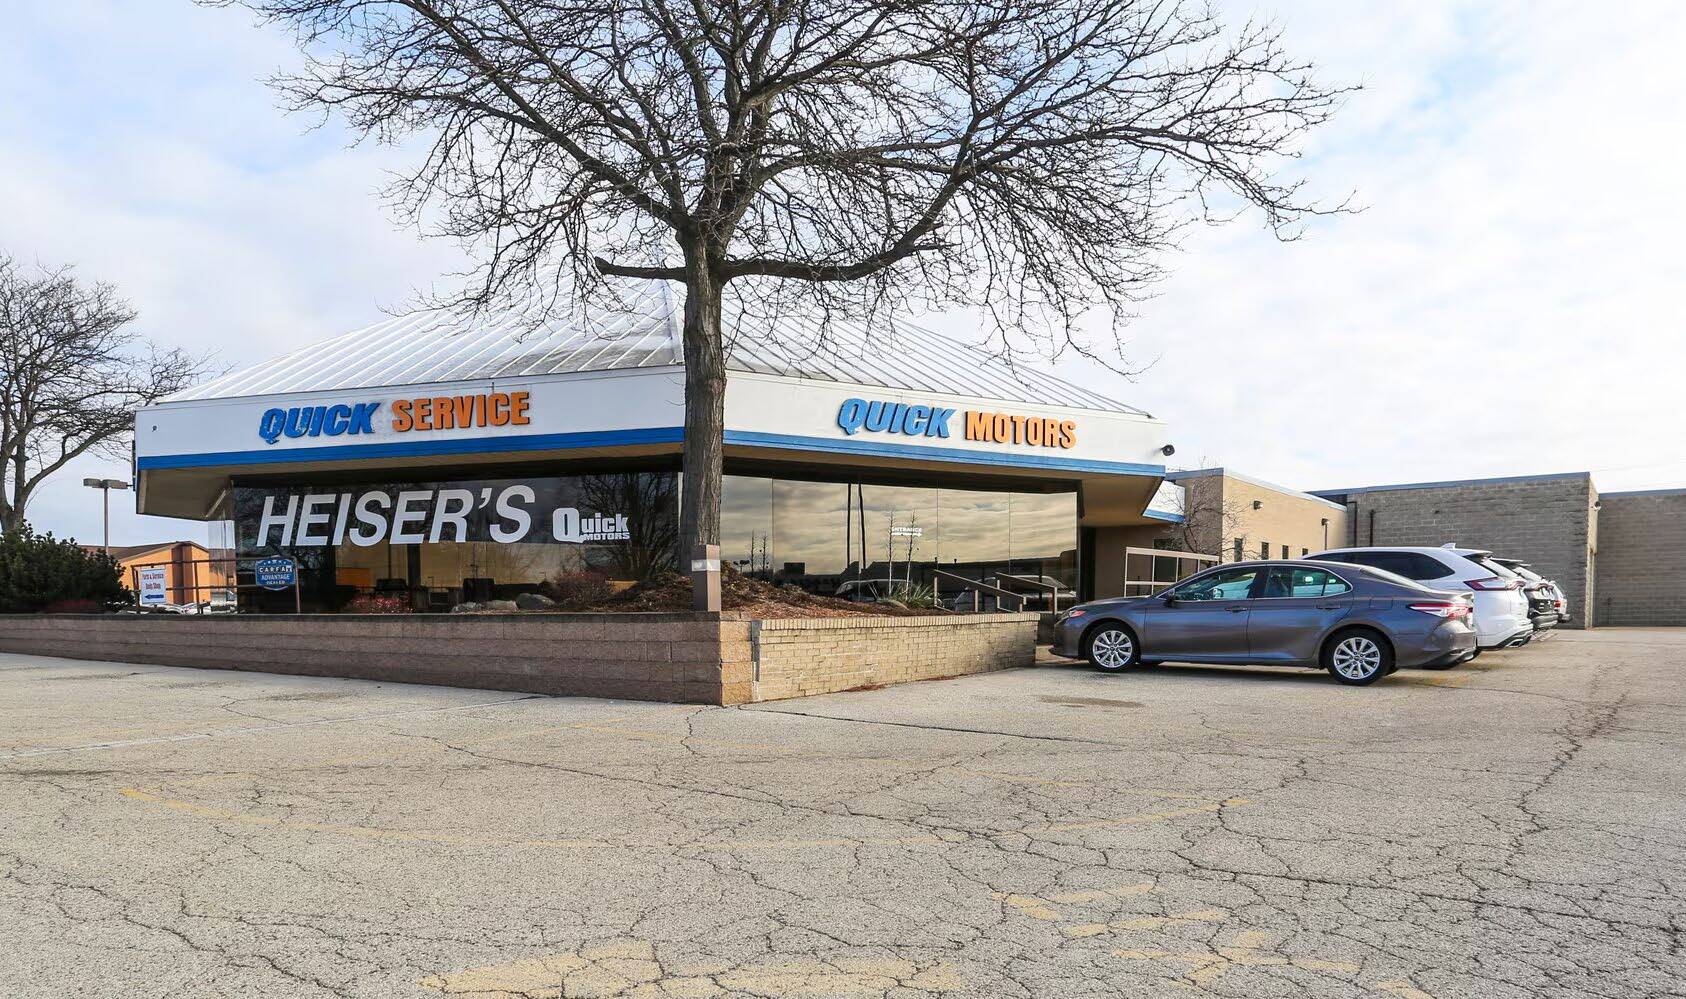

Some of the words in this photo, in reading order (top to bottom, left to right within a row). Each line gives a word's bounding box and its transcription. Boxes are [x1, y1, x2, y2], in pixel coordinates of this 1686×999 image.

[258, 402, 381, 444] QUICK
[391, 391, 531, 432] SERVICE
[837, 398, 957, 438] QUICK
[965, 410, 1077, 449] MOTORS
[256, 484, 536, 547] HEISER'S
[552, 507, 629, 543] Quick
[581, 532, 630, 541] MOTORS
[259, 565, 293, 573] CARFAX
